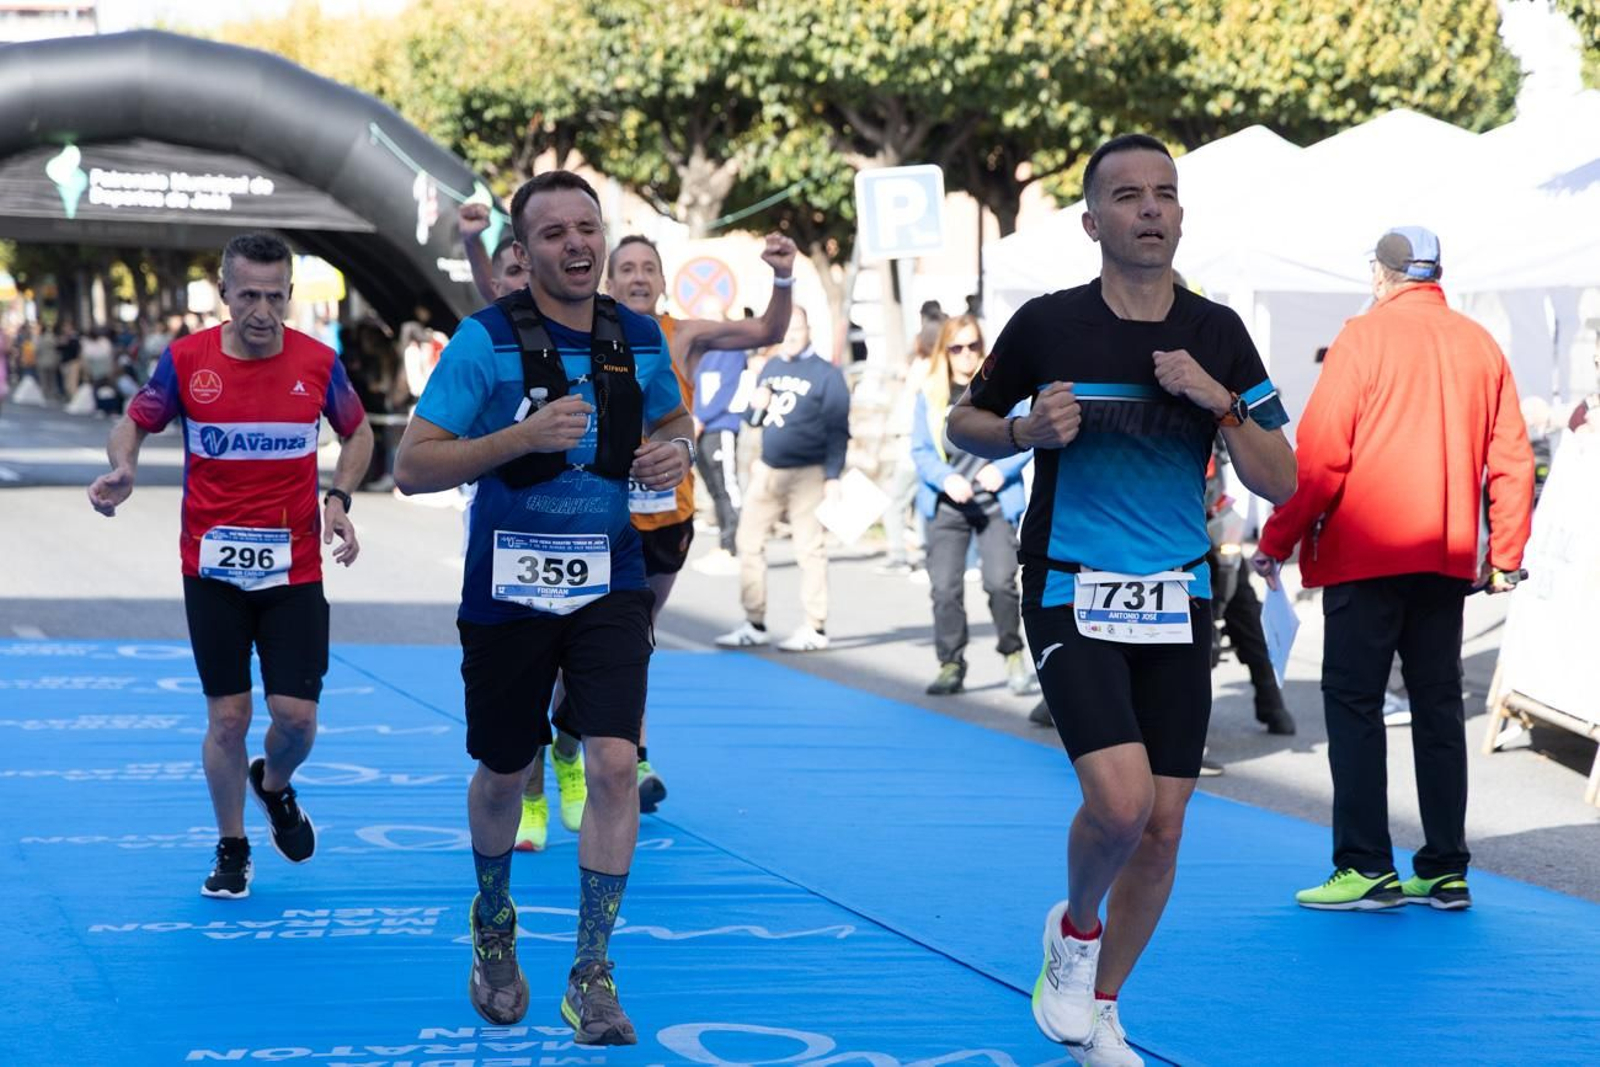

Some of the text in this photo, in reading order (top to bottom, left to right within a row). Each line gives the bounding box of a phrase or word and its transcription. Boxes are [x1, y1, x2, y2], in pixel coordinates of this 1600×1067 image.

[874, 178, 928, 249] P
[231, 433, 306, 451] Avanza
[218, 546, 274, 569] 296
[517, 556, 589, 586] 359
[1100, 581, 1164, 610] 731
[202, 927, 435, 940] MEDIA
[418, 1026, 574, 1040] AÉN
